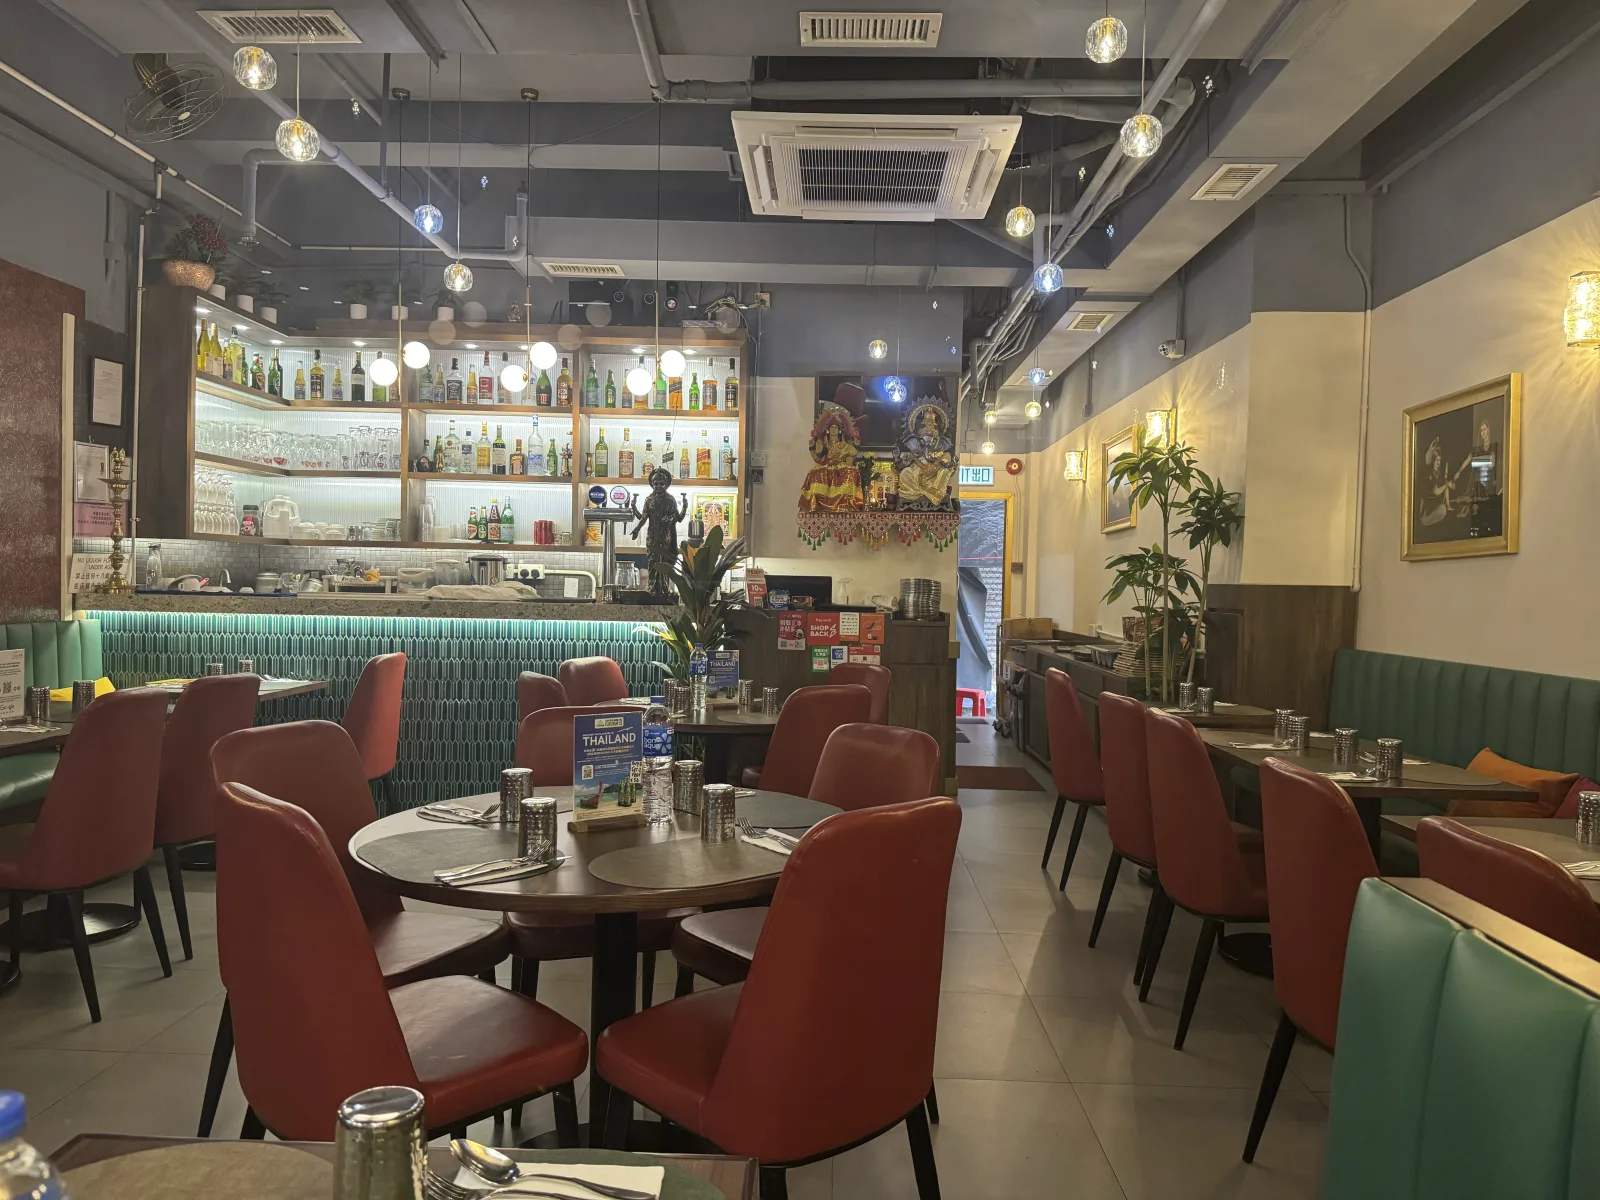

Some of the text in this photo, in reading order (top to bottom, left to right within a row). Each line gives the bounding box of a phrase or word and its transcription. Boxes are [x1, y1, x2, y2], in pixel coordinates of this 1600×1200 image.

[962, 468, 970, 482] IT
[972, 468, 990, 482] 出口
[583, 733, 636, 746] THAILAND
